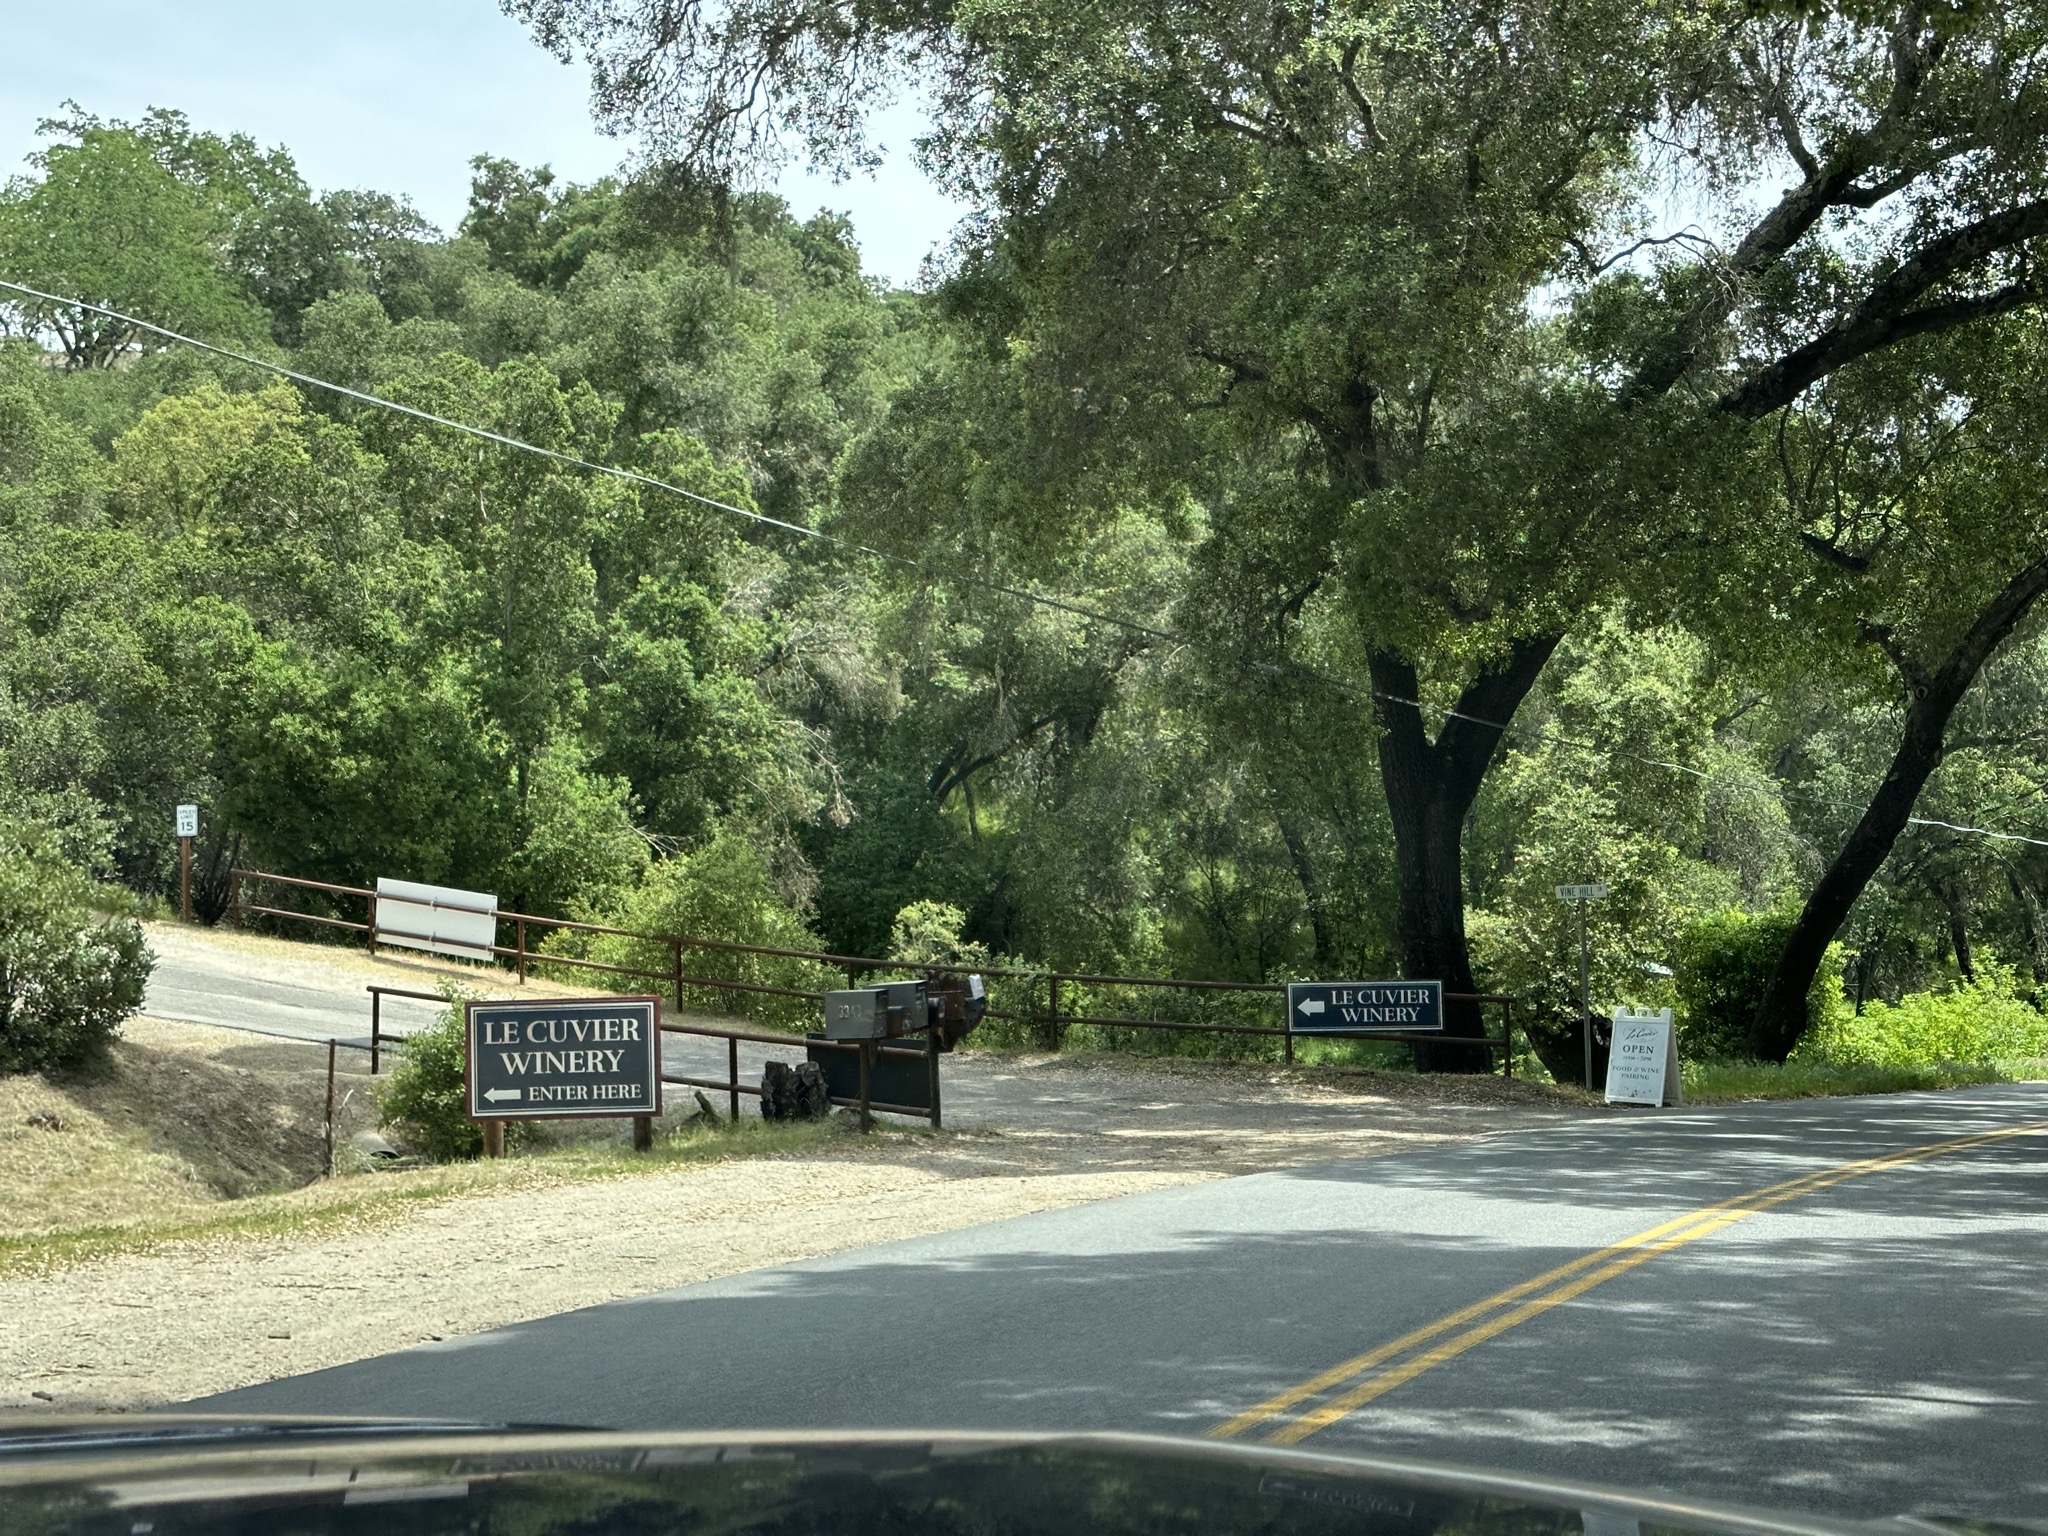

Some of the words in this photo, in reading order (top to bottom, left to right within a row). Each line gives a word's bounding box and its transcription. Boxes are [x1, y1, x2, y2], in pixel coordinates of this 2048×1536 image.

[181, 821, 194, 831] 15
[1560, 886, 1576, 897] VINE
[1579, 886, 1594, 897] HILL
[1331, 990, 1354, 1005] LE
[1358, 989, 1430, 1005] CUVIER
[1341, 1007, 1421, 1022] WINERY
[484, 1021, 520, 1045] LE
[526, 1018, 641, 1044] CUVIER
[1622, 1044, 1654, 1054] OPEN
[500, 1050, 625, 1075] WINERY
[528, 1086, 588, 1101] ENTER
[593, 1084, 642, 1100] HERE
